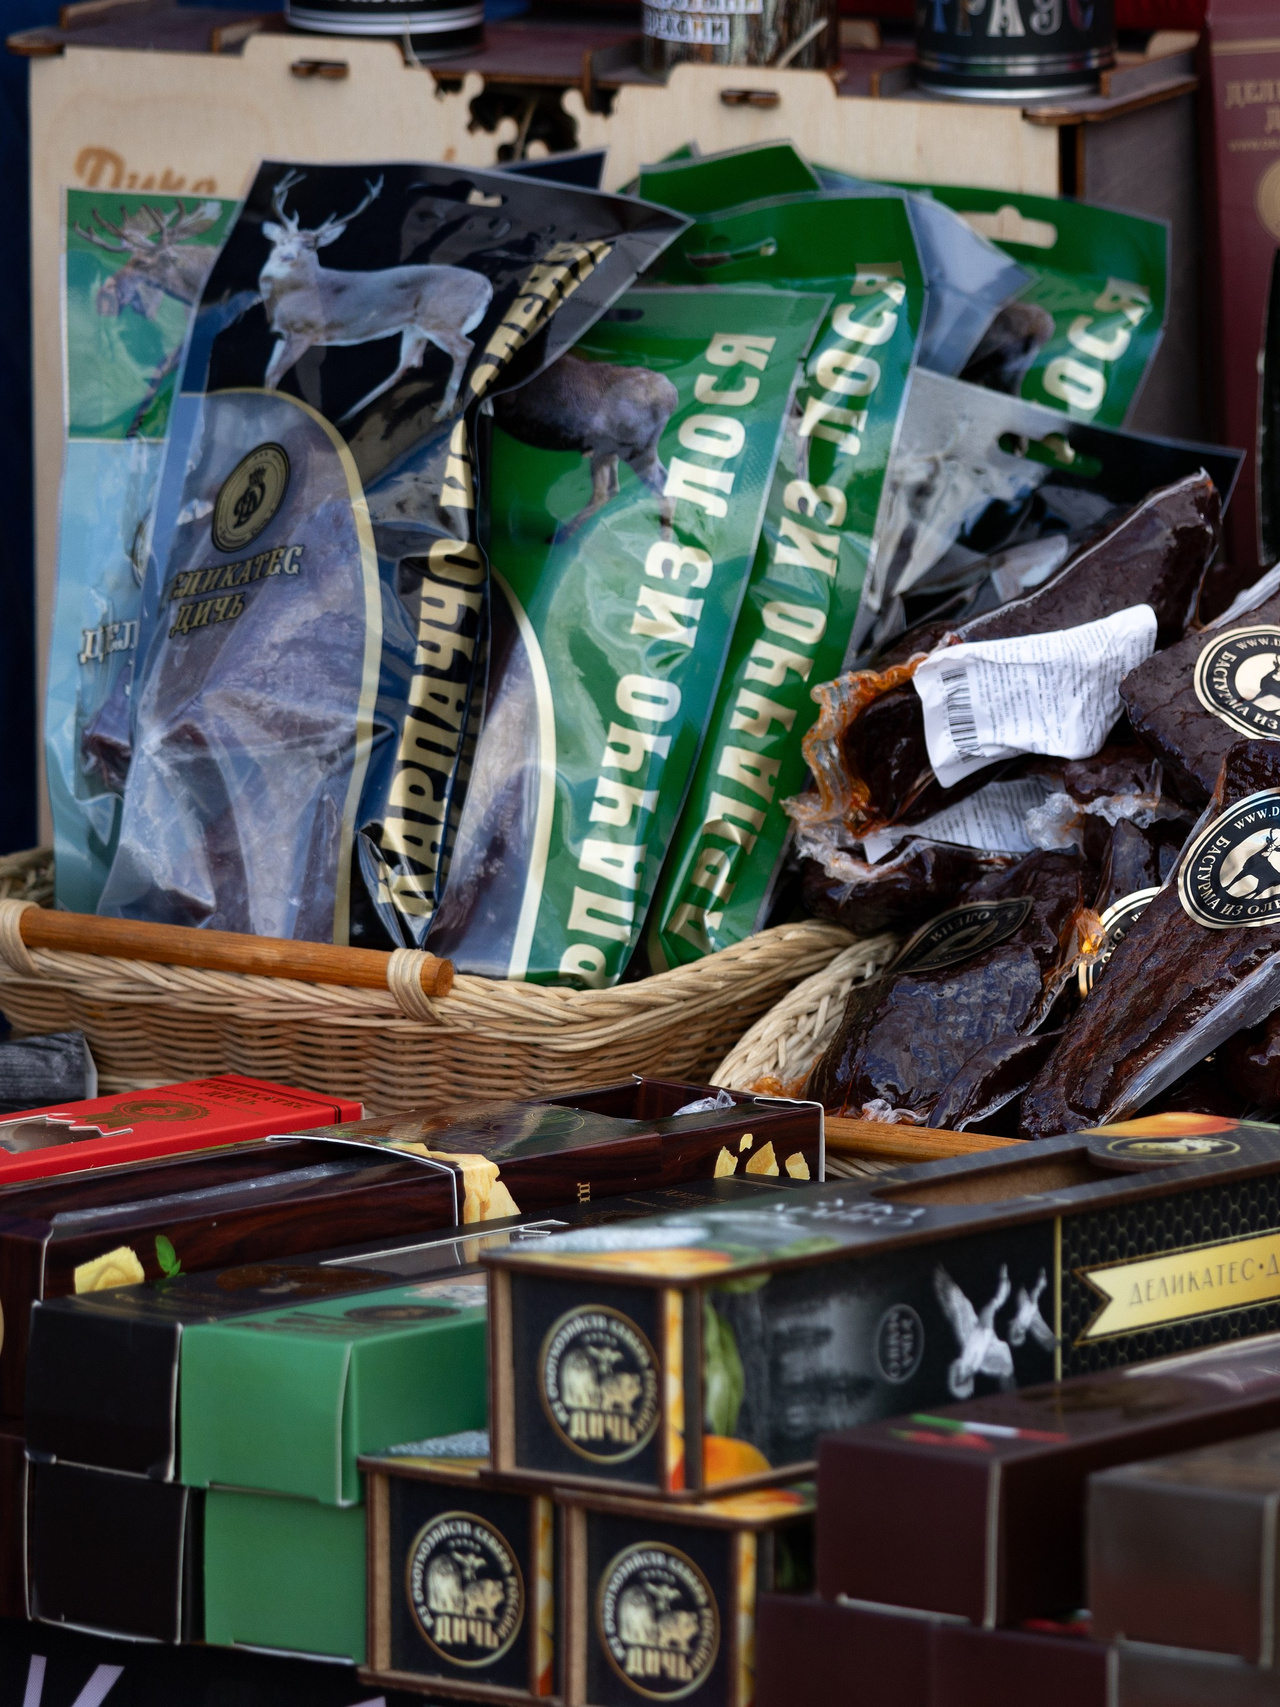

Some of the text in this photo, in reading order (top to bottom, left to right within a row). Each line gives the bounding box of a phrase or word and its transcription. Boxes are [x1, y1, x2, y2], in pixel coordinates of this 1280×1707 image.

[799, 262, 907, 457] ЛОСЯ
[663, 332, 777, 518] ЛОСЯ
[772, 479, 848, 578] ИЗ
[168, 592, 247, 640] ДИЧЬ
[629, 541, 714, 649] ИЗ
[1212, 650, 1250, 717] БАСТУРМА
[1252, 711, 1279, 730] ИЗ
[1196, 835, 1233, 911] БАСТУРМА
[1219, 902, 1244, 917] ИЗ
[568, 1409, 638, 1443] ДИЧЬ
[433, 1614, 500, 1649] ДИЧЬ
[624, 1645, 694, 1683] ДИЧЬ
